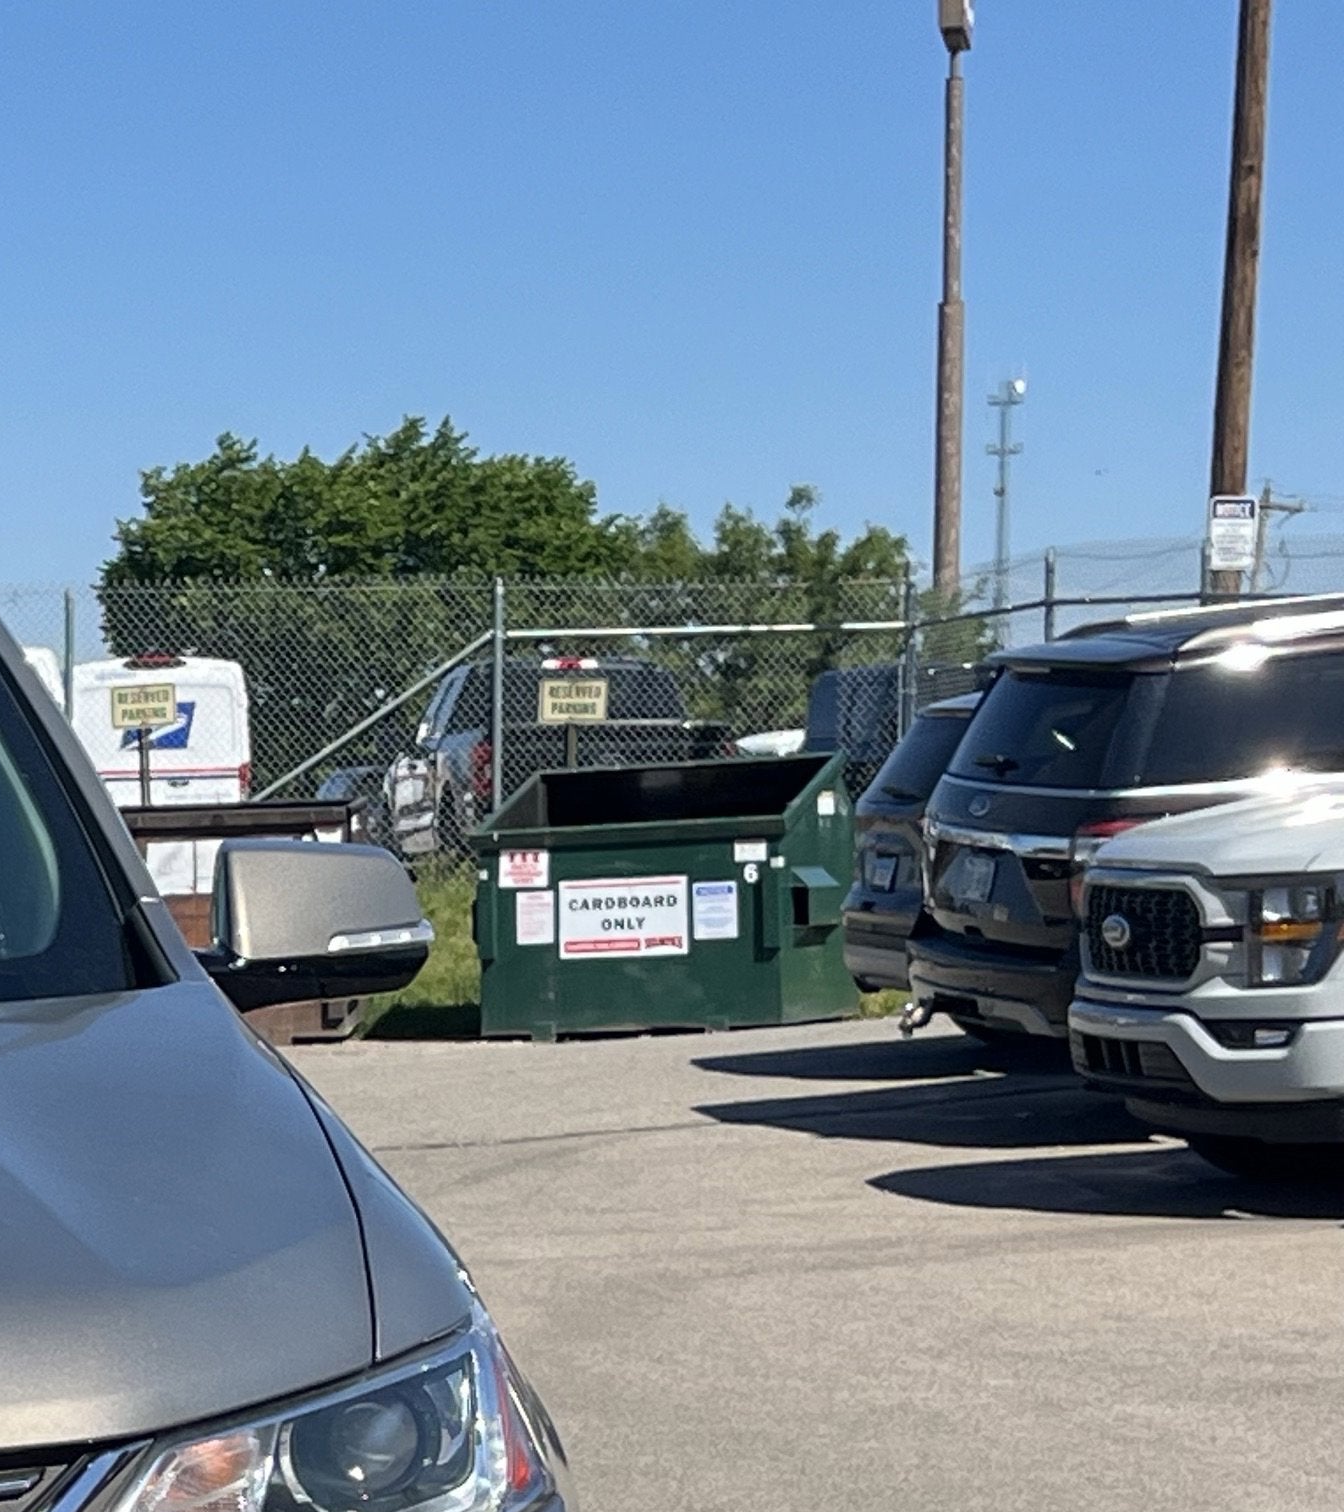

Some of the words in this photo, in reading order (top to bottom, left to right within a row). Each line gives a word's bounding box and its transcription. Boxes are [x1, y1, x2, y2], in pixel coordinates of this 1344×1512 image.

[743, 862, 759, 884] 6
[567, 894, 678, 911] CARDBOARD
[600, 916, 646, 932] ONLY
